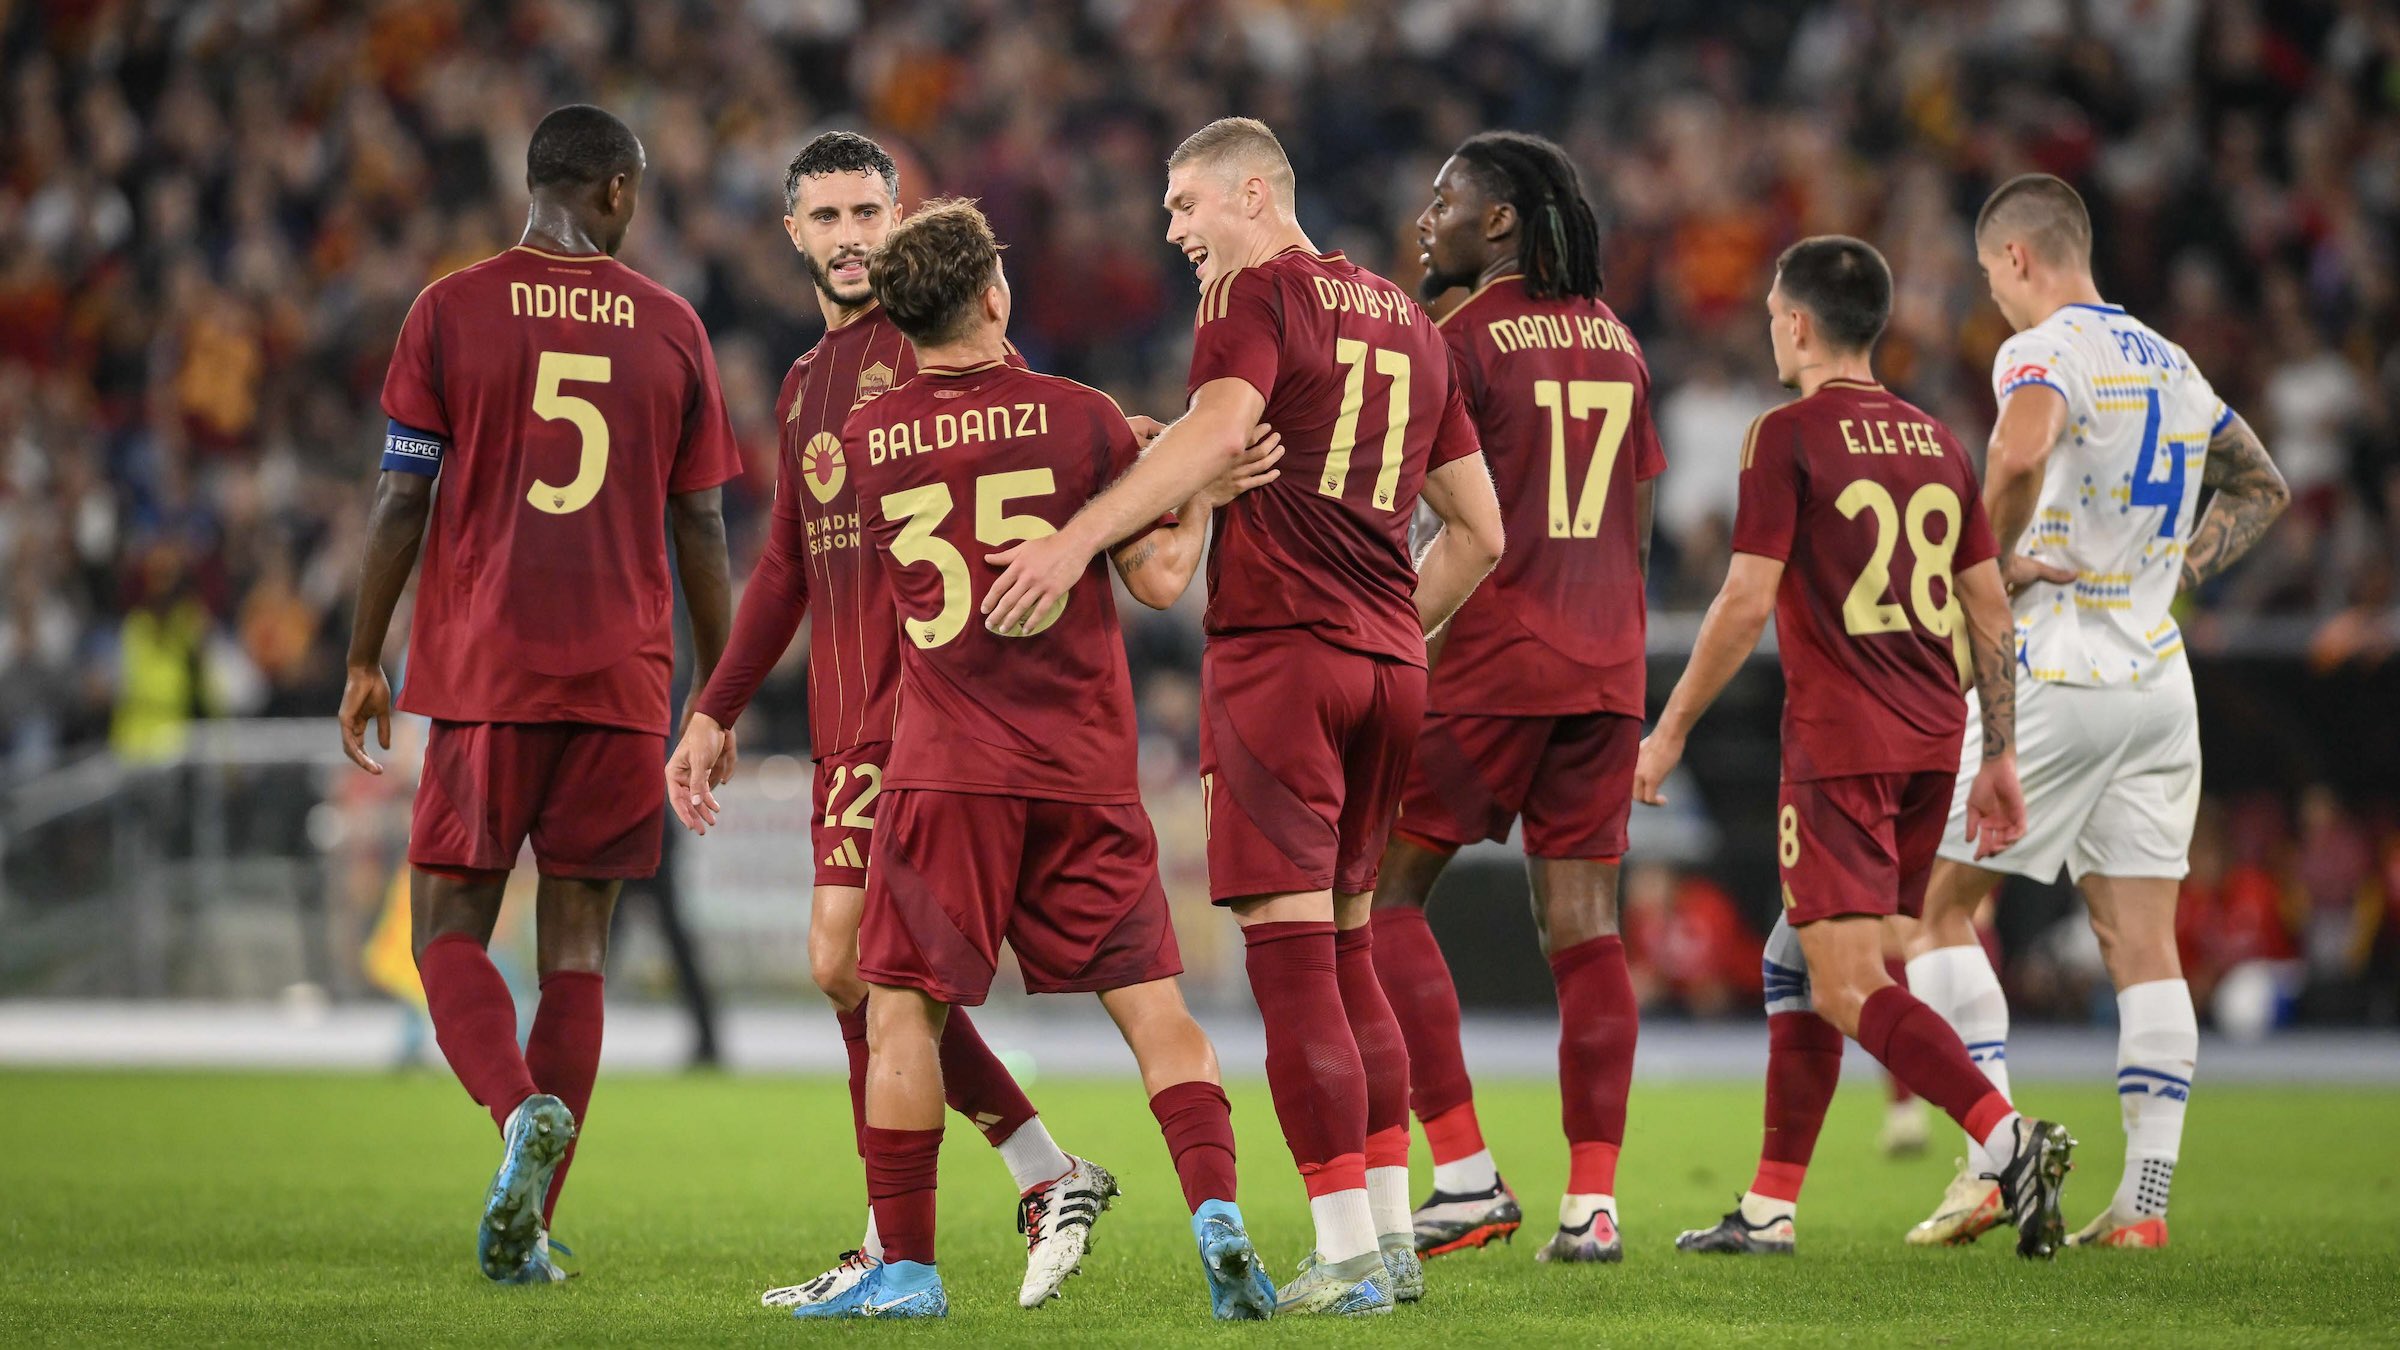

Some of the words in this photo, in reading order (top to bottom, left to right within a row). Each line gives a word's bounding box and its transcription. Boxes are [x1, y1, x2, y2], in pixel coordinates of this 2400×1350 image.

[511, 282, 635, 329] NDICKA
[1313, 276, 1411, 325] DOVBYK
[1488, 314, 1574, 354] MANU
[395, 440, 440, 457] RESPECT
[526, 351, 612, 515] 5
[868, 403, 1048, 466] BALDANZI
[1318, 338, 1411, 512] 11
[1897, 421, 1944, 457] FEE
[1534, 380, 1635, 539] 17
[2130, 388, 2186, 538] 4
[810, 531, 860, 556] SESON
[880, 467, 1069, 649] 35
[1834, 479, 1965, 640] 28
[824, 763, 882, 829] 22
